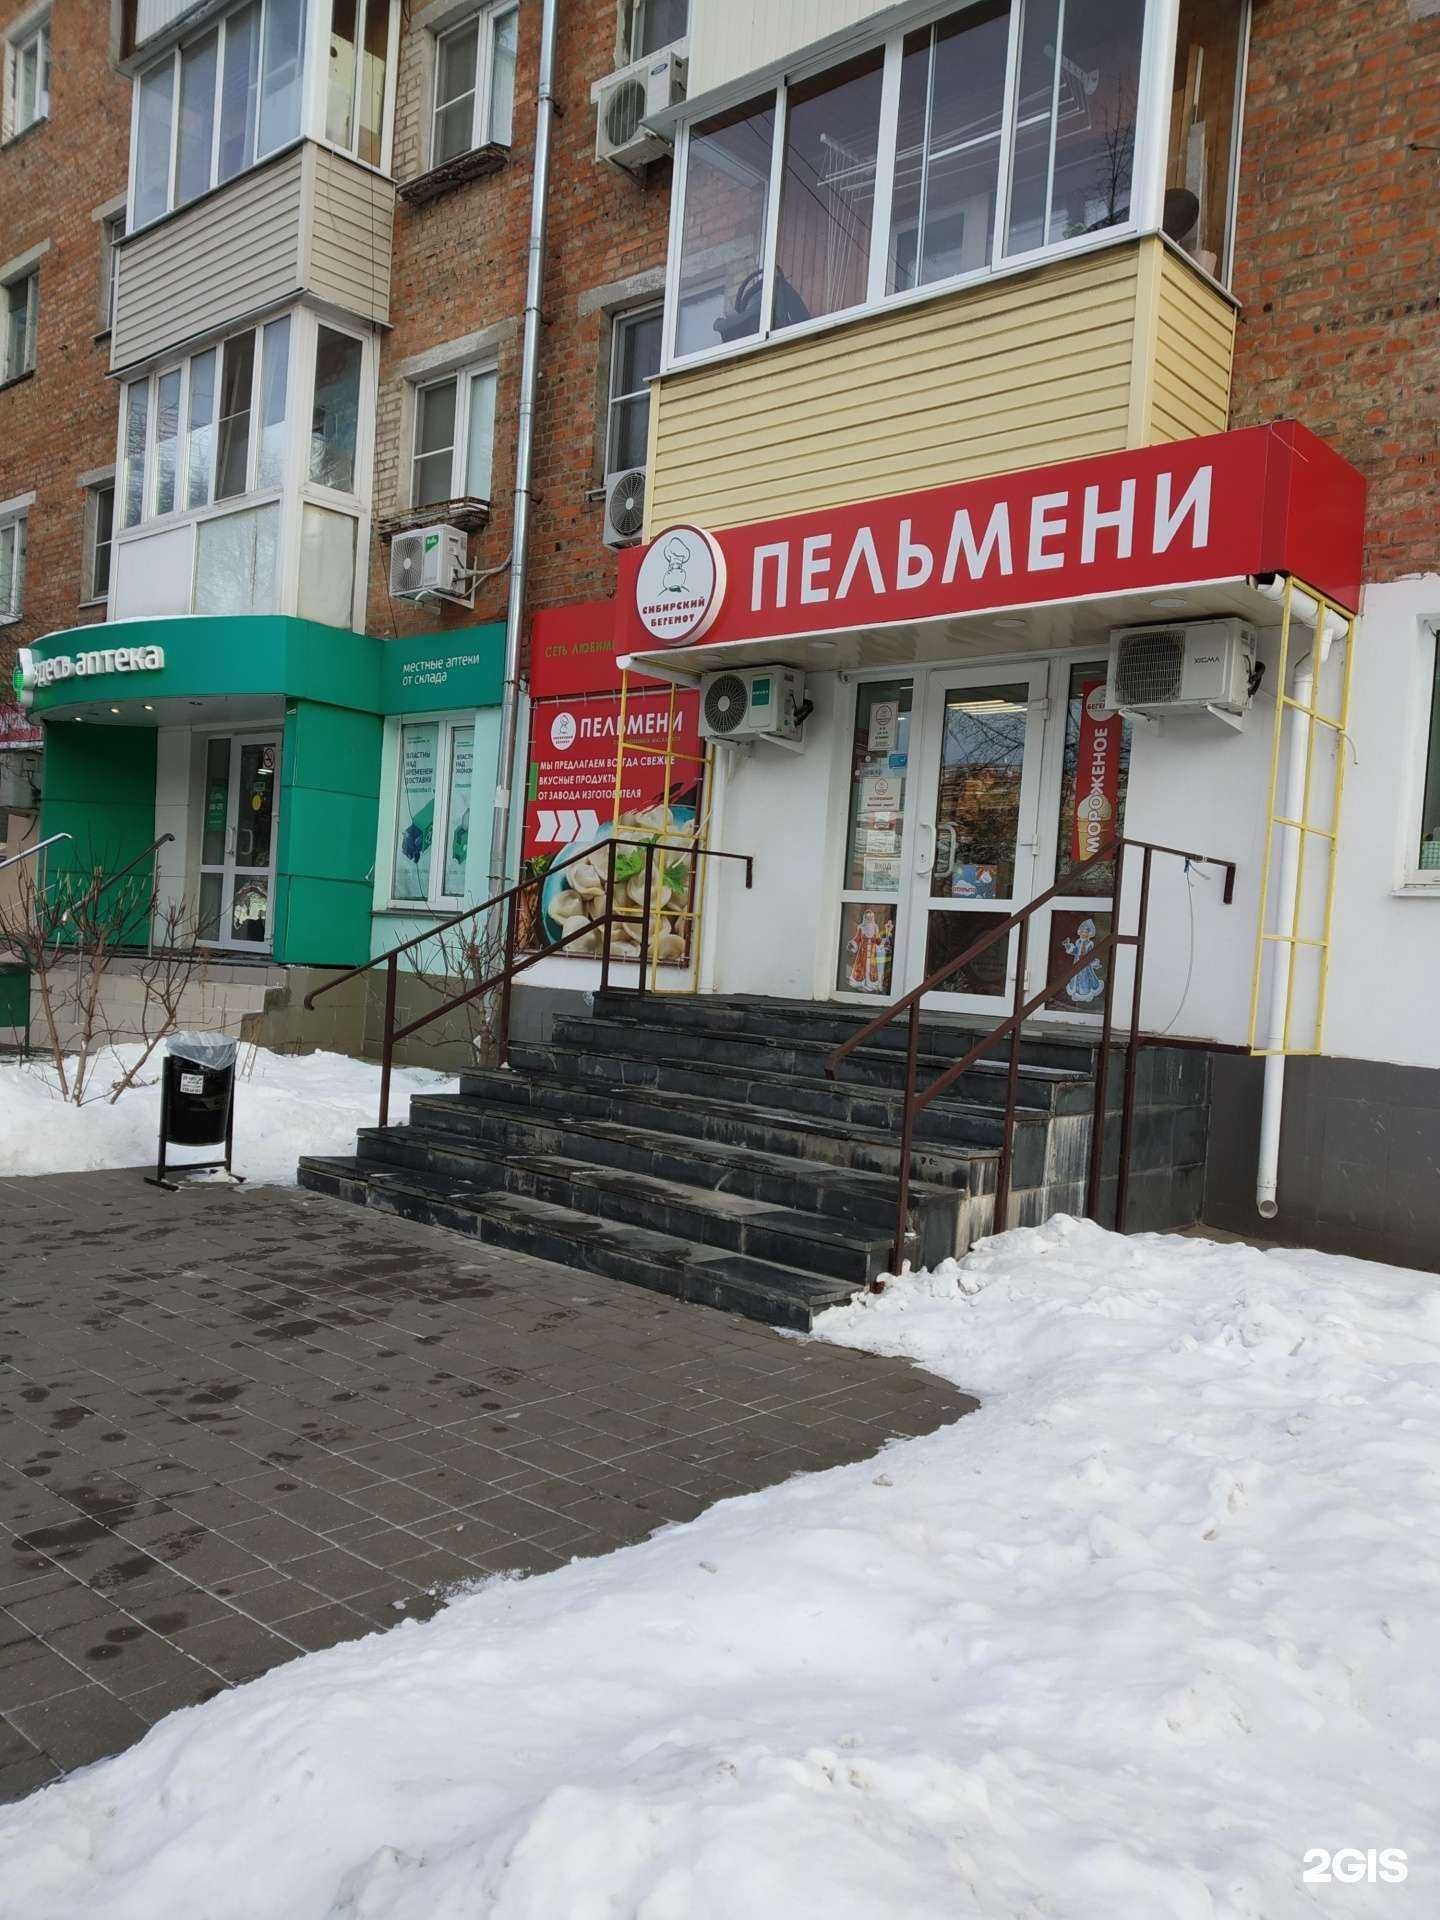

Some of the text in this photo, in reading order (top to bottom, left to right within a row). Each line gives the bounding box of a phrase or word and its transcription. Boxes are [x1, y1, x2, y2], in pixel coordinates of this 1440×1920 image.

[751, 465, 1213, 612] ПЕЛЬМЕНИ
[642, 596, 705, 615] СИБИРСКИЙ
[650, 613, 695, 627] БЕГЕМОТ
[544, 640, 615, 658] СЕТЬ ЛЮБИМ
[74, 644, 166, 676] аптека
[402, 654, 480, 673] местные аптеки
[402, 671, 448, 687] от склада
[540, 755, 676, 771] МЫ ПРЕДЛАГАЕМ ВСГДА СВЕЖЕ
[539, 775, 575, 786] ВКУСНЫЕ
[538, 791, 548, 801] ОТ
[548, 789, 581, 801] ЗАВОДА
[1086, 727, 1109, 853] МОРОЖЕНОЕ
